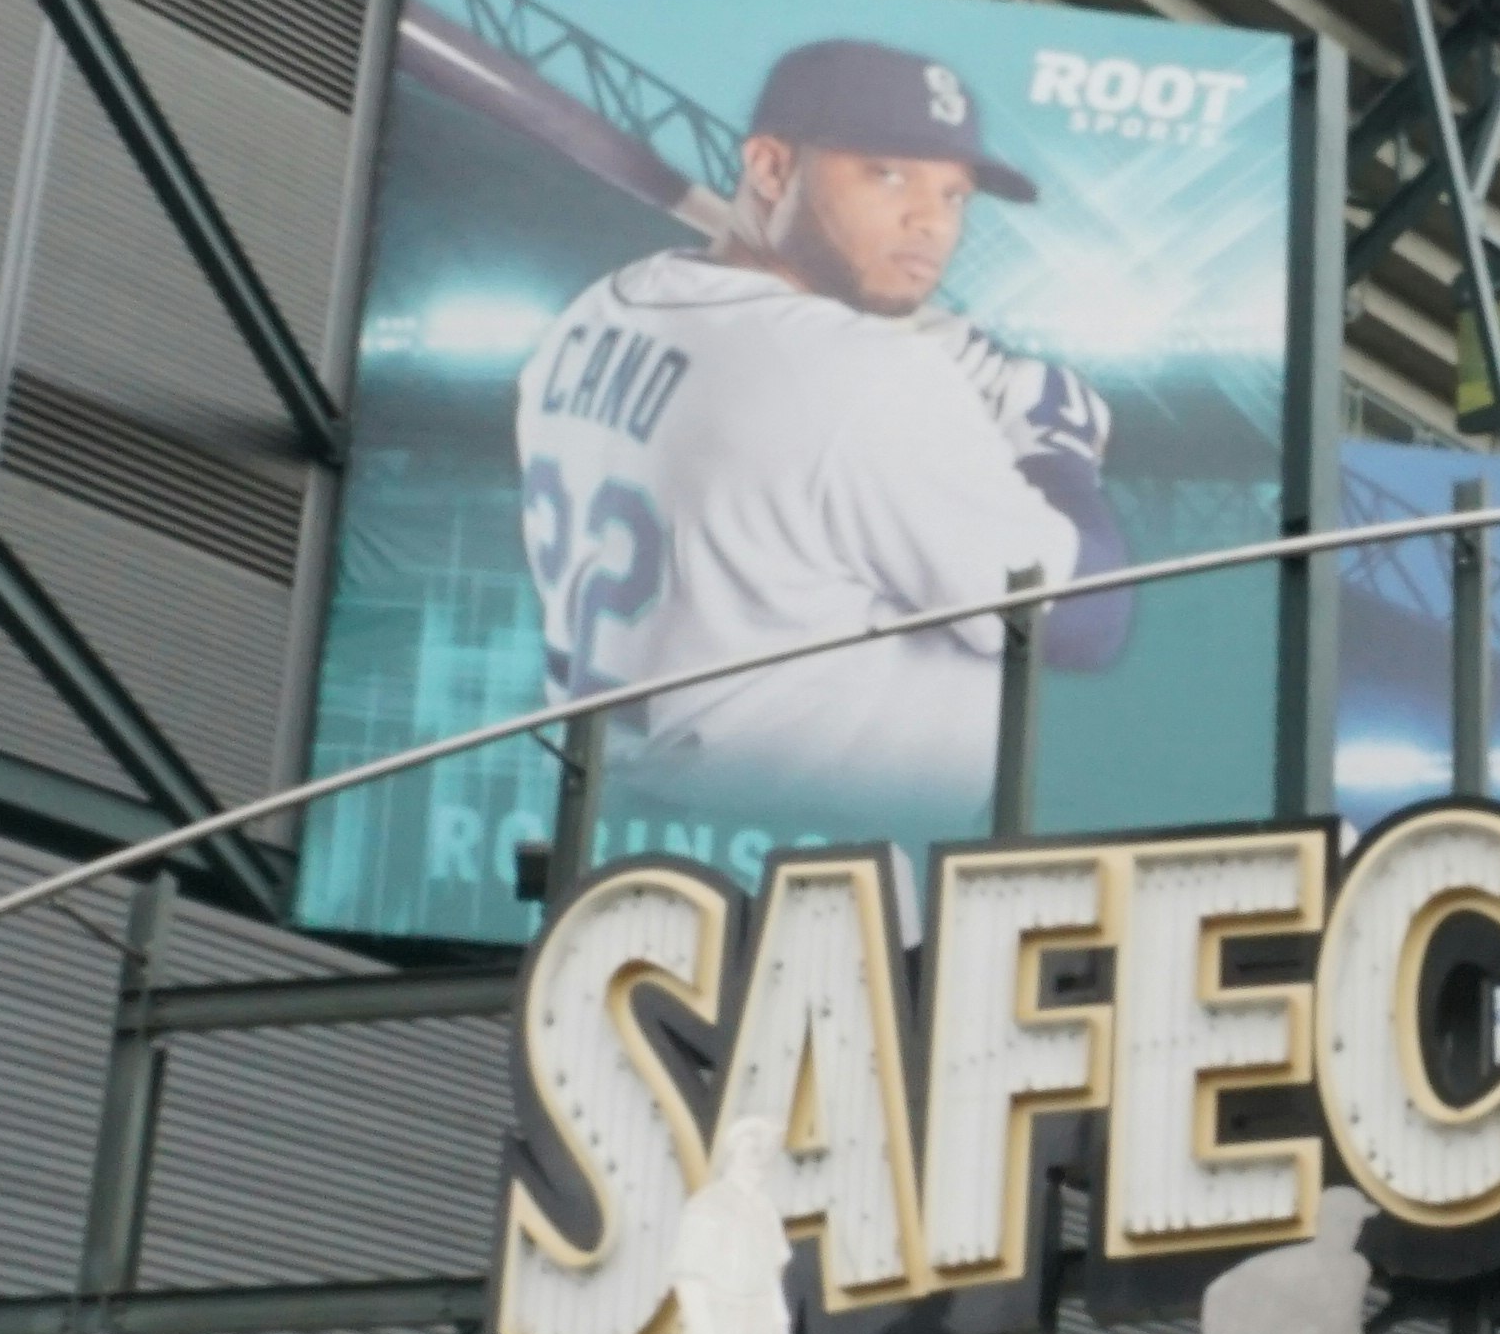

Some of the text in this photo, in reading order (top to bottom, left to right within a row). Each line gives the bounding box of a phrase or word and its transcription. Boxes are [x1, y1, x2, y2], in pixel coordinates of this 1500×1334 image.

[1030, 48, 1247, 124] ROOT
[1068, 109, 1218, 148] SPORTS
[542, 323, 690, 445] CANO
